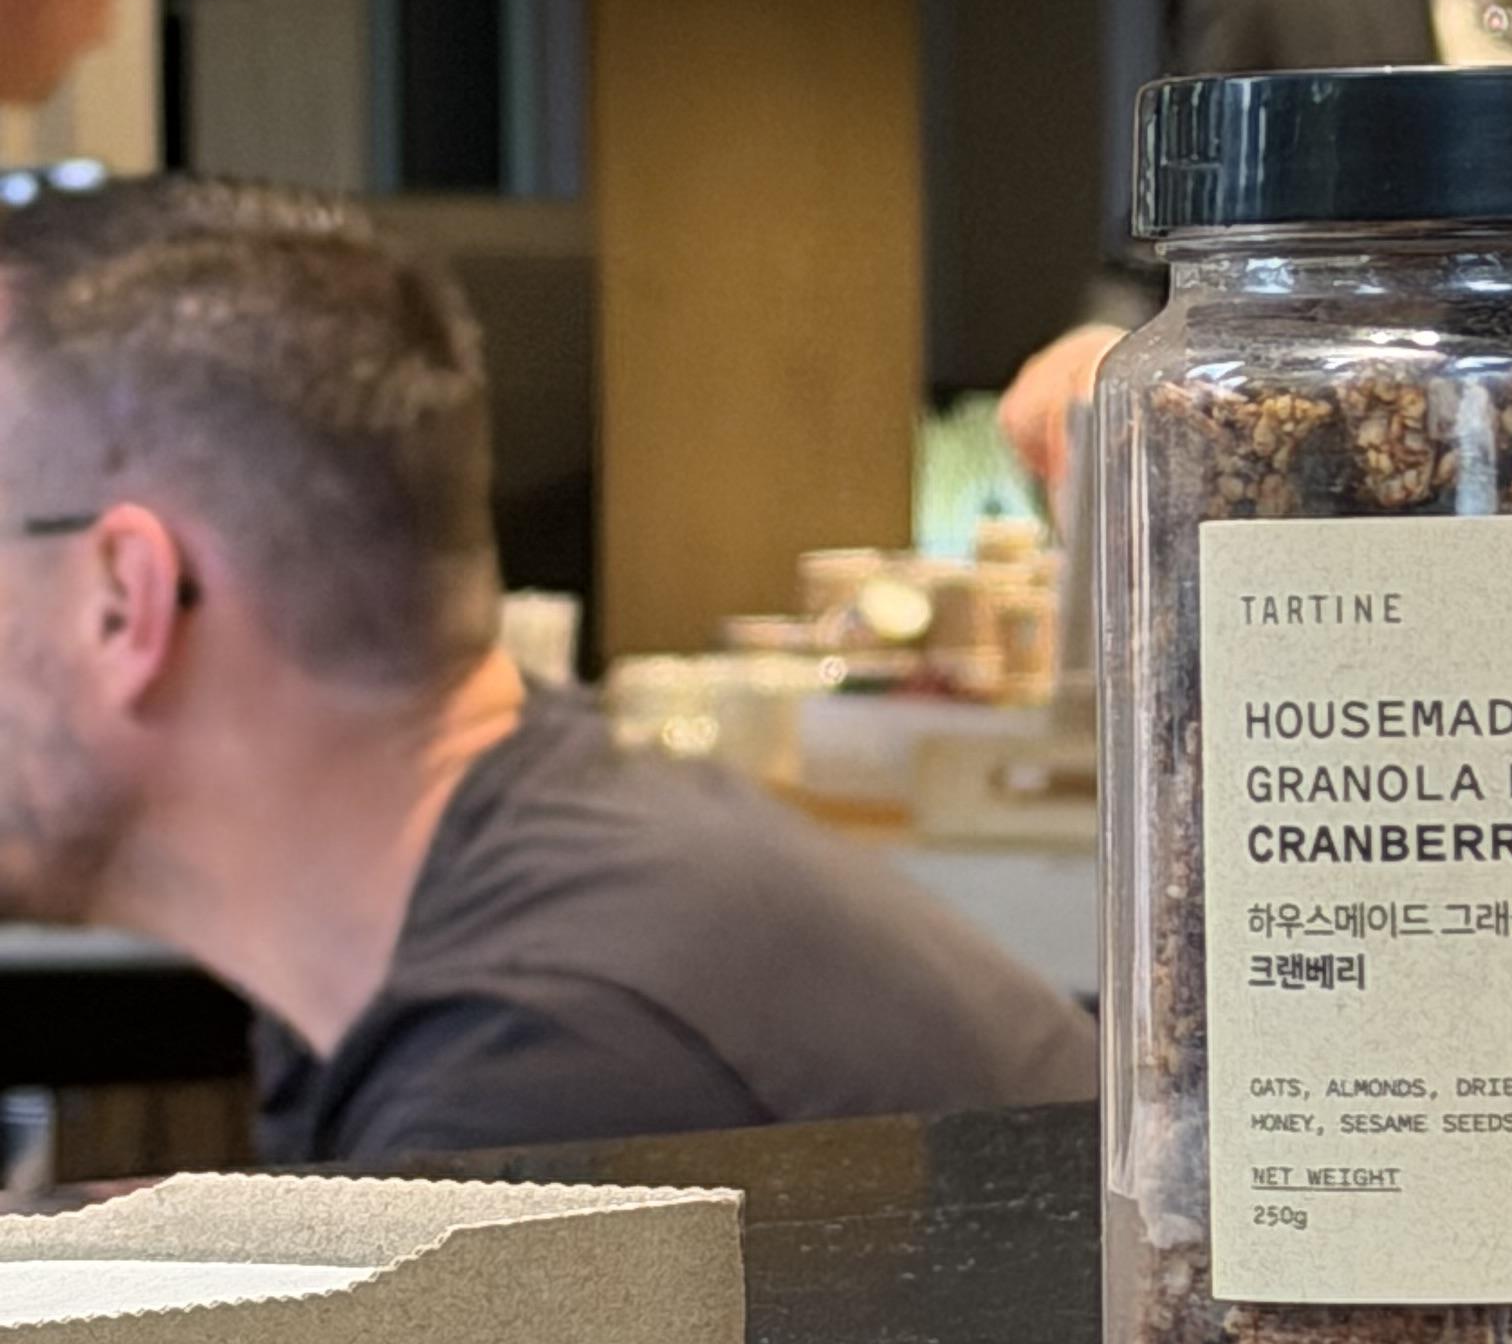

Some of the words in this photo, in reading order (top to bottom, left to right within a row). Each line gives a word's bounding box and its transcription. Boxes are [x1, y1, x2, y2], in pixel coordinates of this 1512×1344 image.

[1241, 592, 1402, 625] TARTINE
[1246, 763, 1485, 803] GRANOLA
[1248, 901, 1434, 939] 하우스메이드
[1248, 953, 1365, 990] 크랜베리
[1249, 1077, 1311, 1101] OATS,
[1325, 1078, 1438, 1101] ALMONDS,
[1251, 1113, 1325, 1136] HONEY,
[1340, 1113, 1427, 1134] SESAME
[1251, 1166, 1293, 1188] NET
[1306, 1167, 1400, 1188] WEIGHT
[1253, 1205, 1308, 1231] 250g
